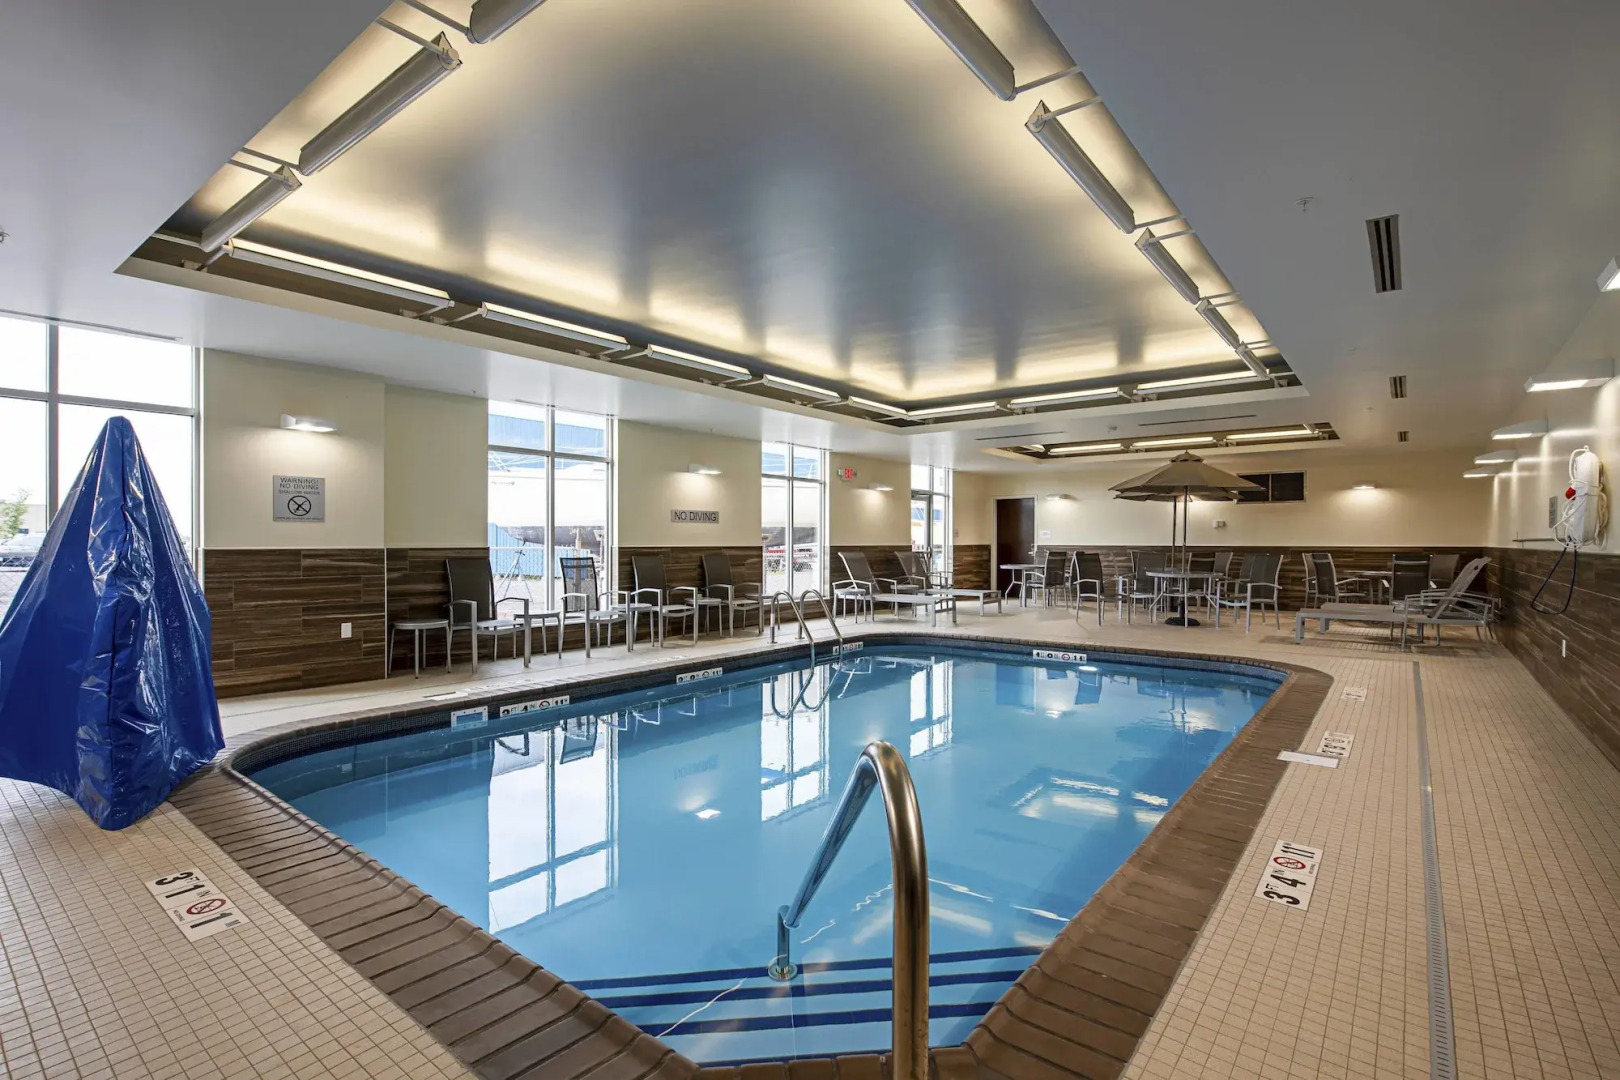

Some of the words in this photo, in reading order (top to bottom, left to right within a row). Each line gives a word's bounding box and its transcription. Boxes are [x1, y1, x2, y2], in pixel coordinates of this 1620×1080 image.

[674, 511, 687, 521] NO
[689, 511, 717, 522] DIVING
[155, 871, 194, 886] 3
[1270, 874, 1306, 888] 4
[165, 884, 205, 899] 1
[1263, 890, 1300, 905] 3
